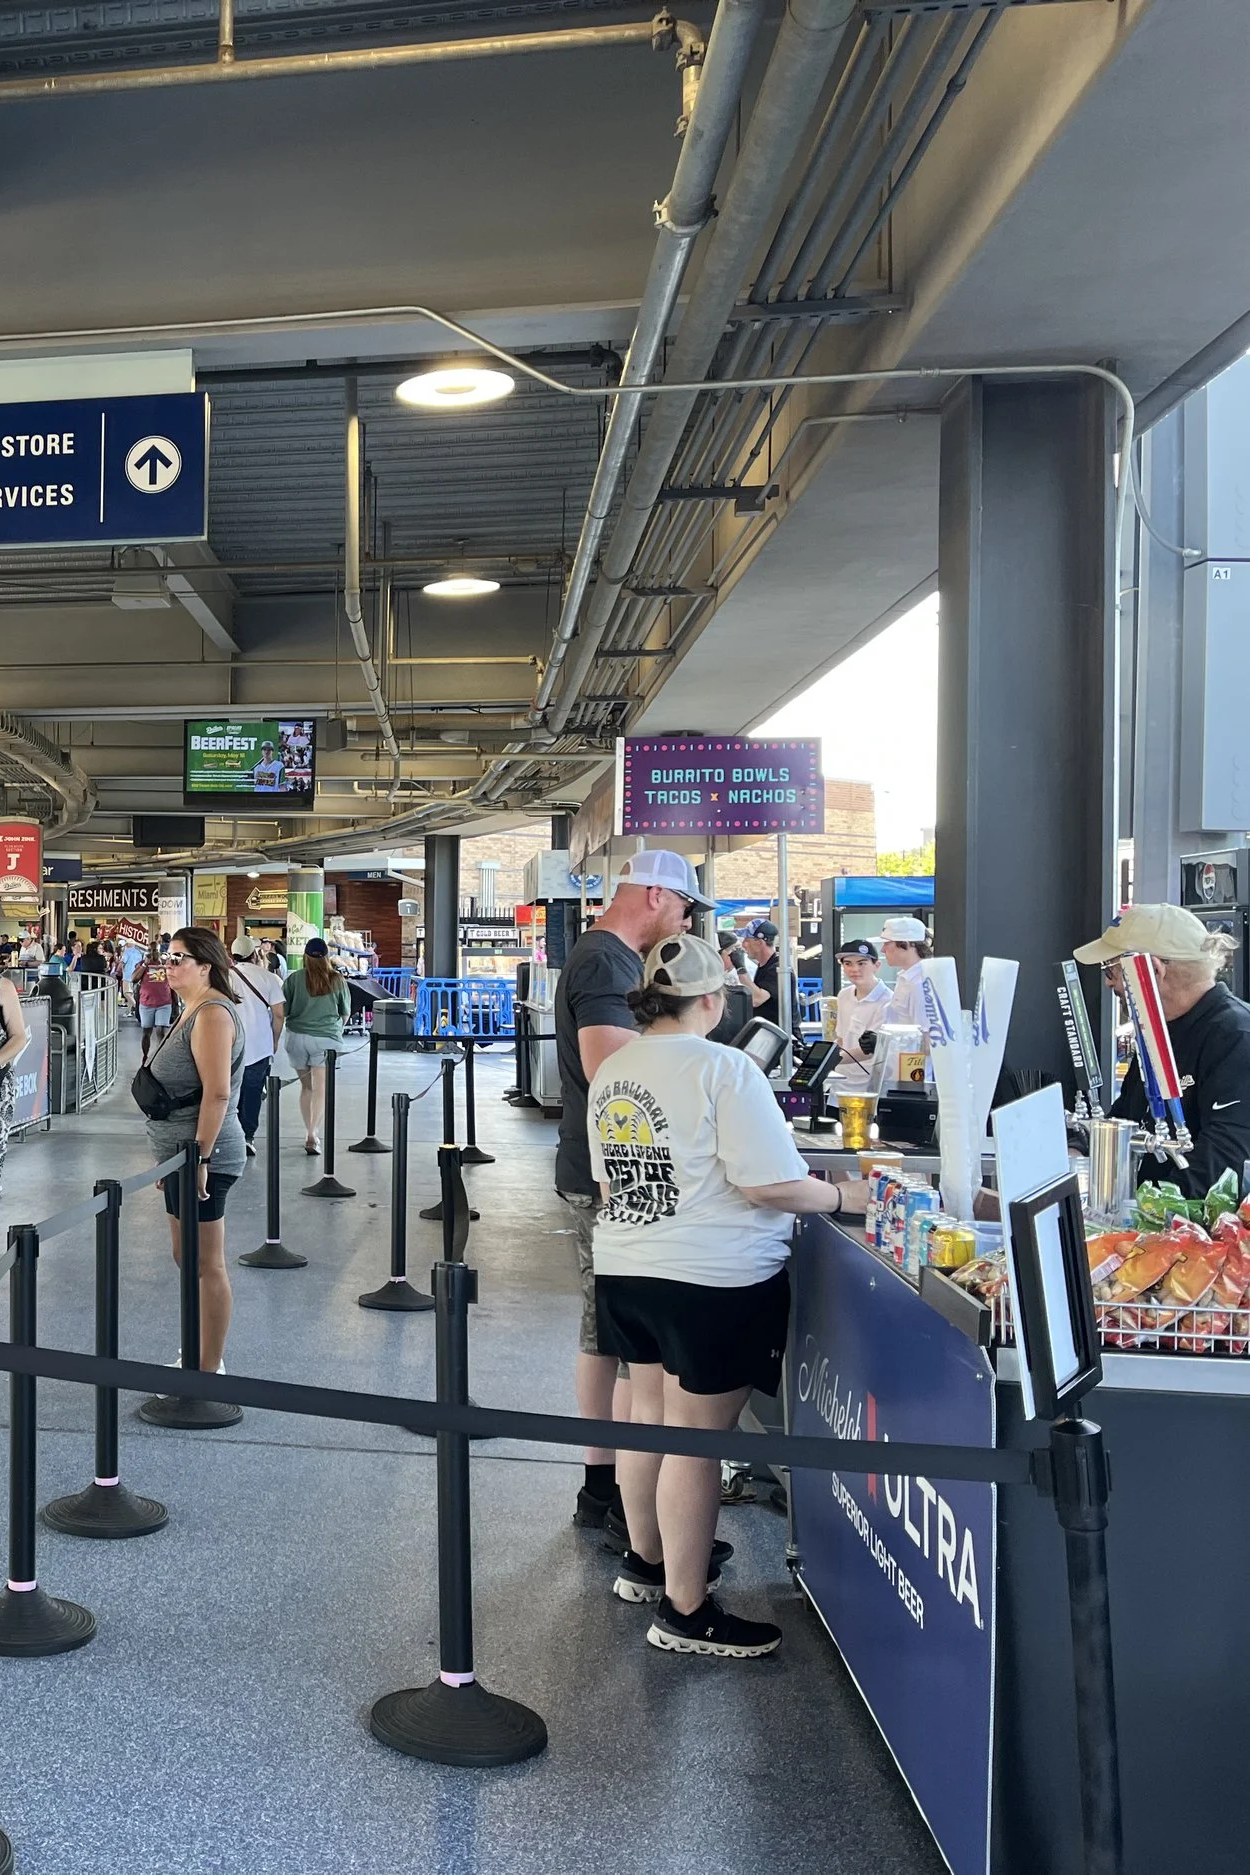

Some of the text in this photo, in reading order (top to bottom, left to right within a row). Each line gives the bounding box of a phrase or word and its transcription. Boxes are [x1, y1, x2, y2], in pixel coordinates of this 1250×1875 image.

[1, 433, 75, 457] STORE
[652, 768, 790, 783] BURRITO BOWLS
[644, 789, 702, 804] TACOS
[728, 789, 797, 804] NACHOS
[7, 853, 20, 870] J
[69, 888, 147, 908] RESHMENTS
[158, 900, 183, 908] DOM
[198, 891, 219, 900] Miami
[923, 976, 949, 1048] Drillers
[1057, 986, 1072, 1017] CRAFT
[1064, 1019, 1084, 1068] STANDARD
[613, 1080, 669, 1133] BALLPARK
[884, 1433, 981, 1630] ULTRA
[831, 1472, 924, 1630] SUPERIOR LIGHT BEER
